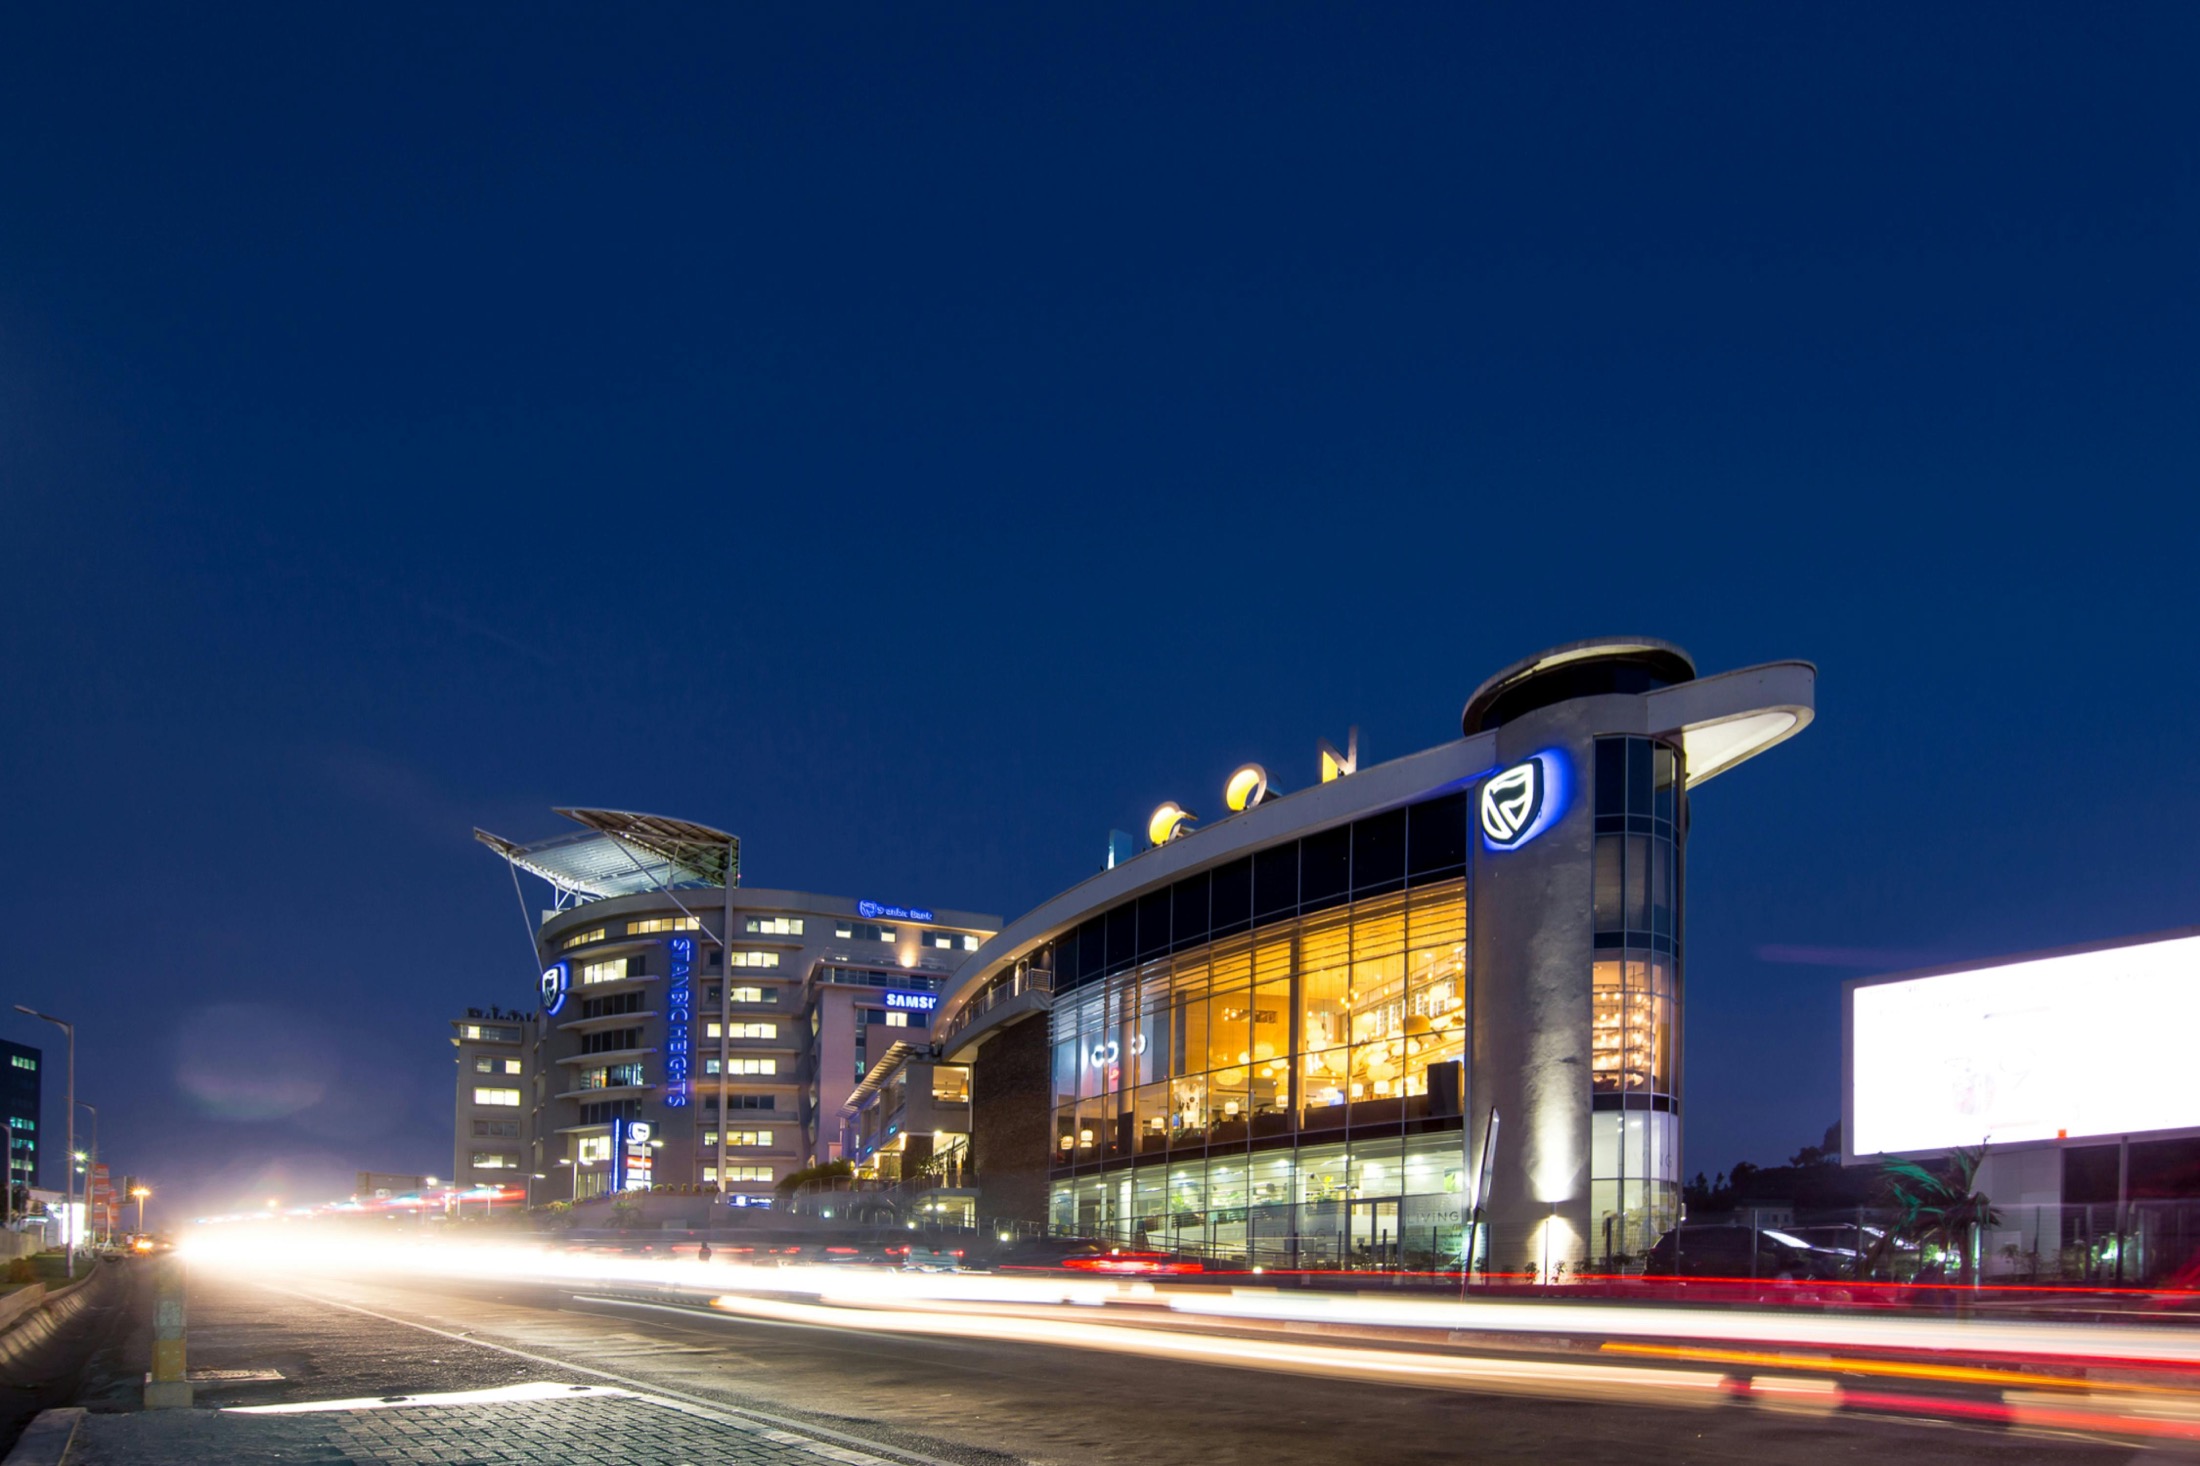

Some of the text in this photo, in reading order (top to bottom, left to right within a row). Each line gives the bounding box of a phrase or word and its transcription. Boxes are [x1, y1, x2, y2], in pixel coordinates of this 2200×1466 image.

[910, 909, 933, 921] Bank
[668, 938, 690, 1107] STANBIC HEIGHTS
